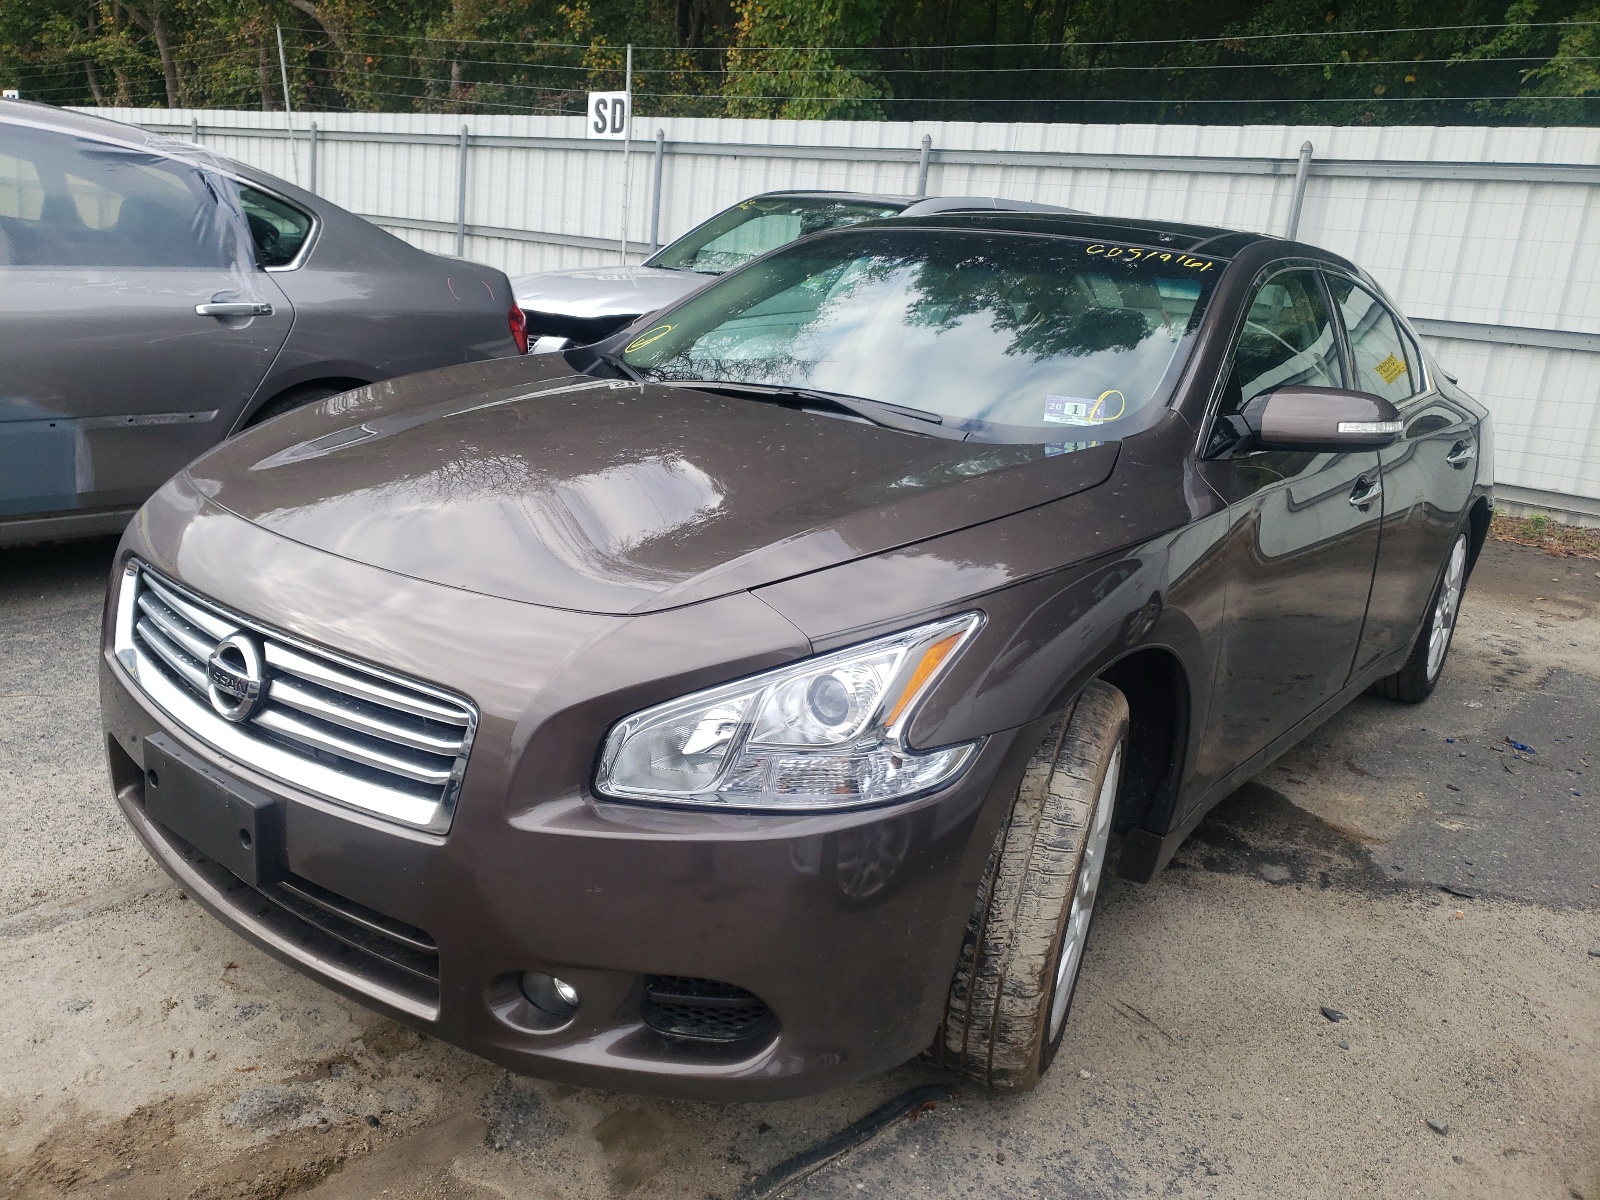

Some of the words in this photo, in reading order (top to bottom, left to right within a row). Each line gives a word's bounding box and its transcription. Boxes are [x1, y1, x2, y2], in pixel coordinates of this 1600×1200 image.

[593, 98, 625, 134] SD
[1049, 402, 1062, 411] 20
[1071, 404, 1079, 416] 1
[209, 667, 249, 696] SSAN
